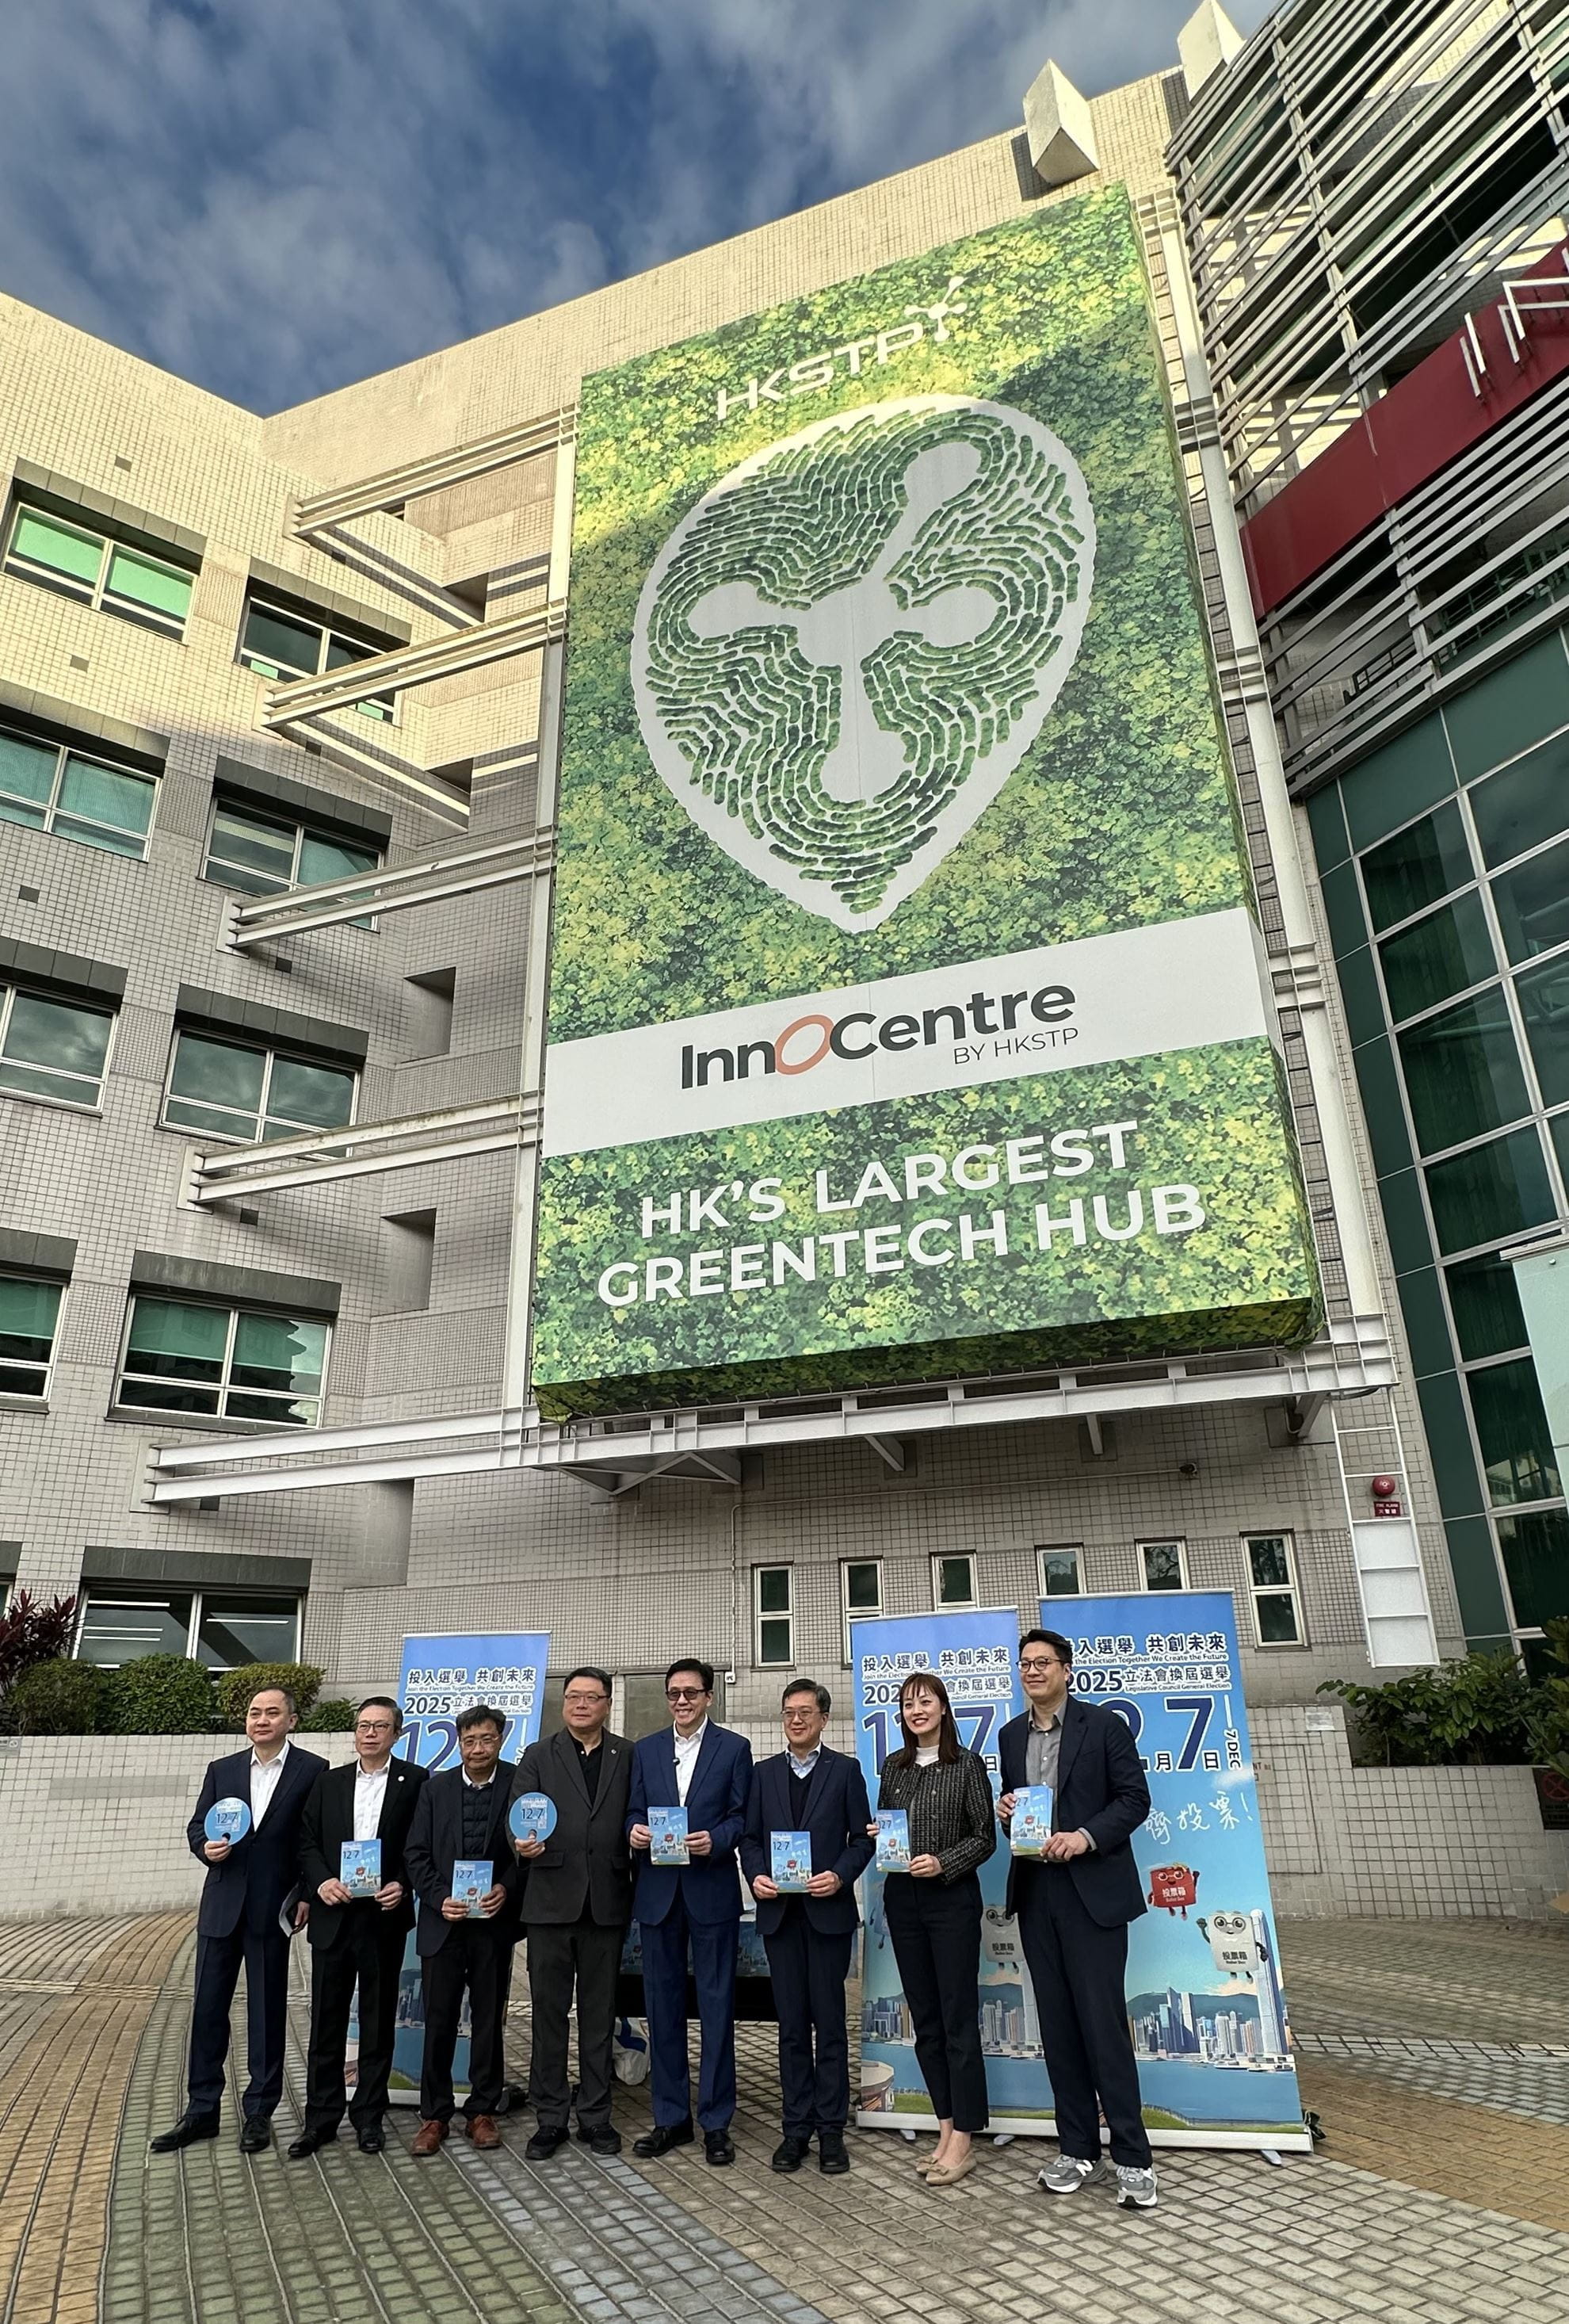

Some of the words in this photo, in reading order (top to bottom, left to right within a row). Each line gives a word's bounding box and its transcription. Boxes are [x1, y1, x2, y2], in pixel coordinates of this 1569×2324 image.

[717, 321, 924, 421] HKSTP
[952, 1040, 987, 1066] BY
[994, 1026, 1079, 1059] HKSTP
[641, 1176, 785, 1240] HK'S
[816, 1119, 1140, 1214] LARGEST
[597, 1210, 1010, 1307] GREENTECH
[1036, 1182, 1207, 1252] HUB
[1071, 1638, 1132, 1655] 入選舉
[1148, 1634, 1225, 1653] 共創未來
[864, 1653, 929, 1672] 投入選舉
[941, 1648, 1008, 1666] 共創未來
[408, 1670, 466, 1684] 投入選舉
[477, 1668, 535, 1683] 共創未來
[865, 1685, 901, 1704] 202
[946, 1677, 1010, 1693] 會換屆選舉
[404, 1696, 451, 1714] 2025
[1227, 1741, 1241, 1768] DEC
